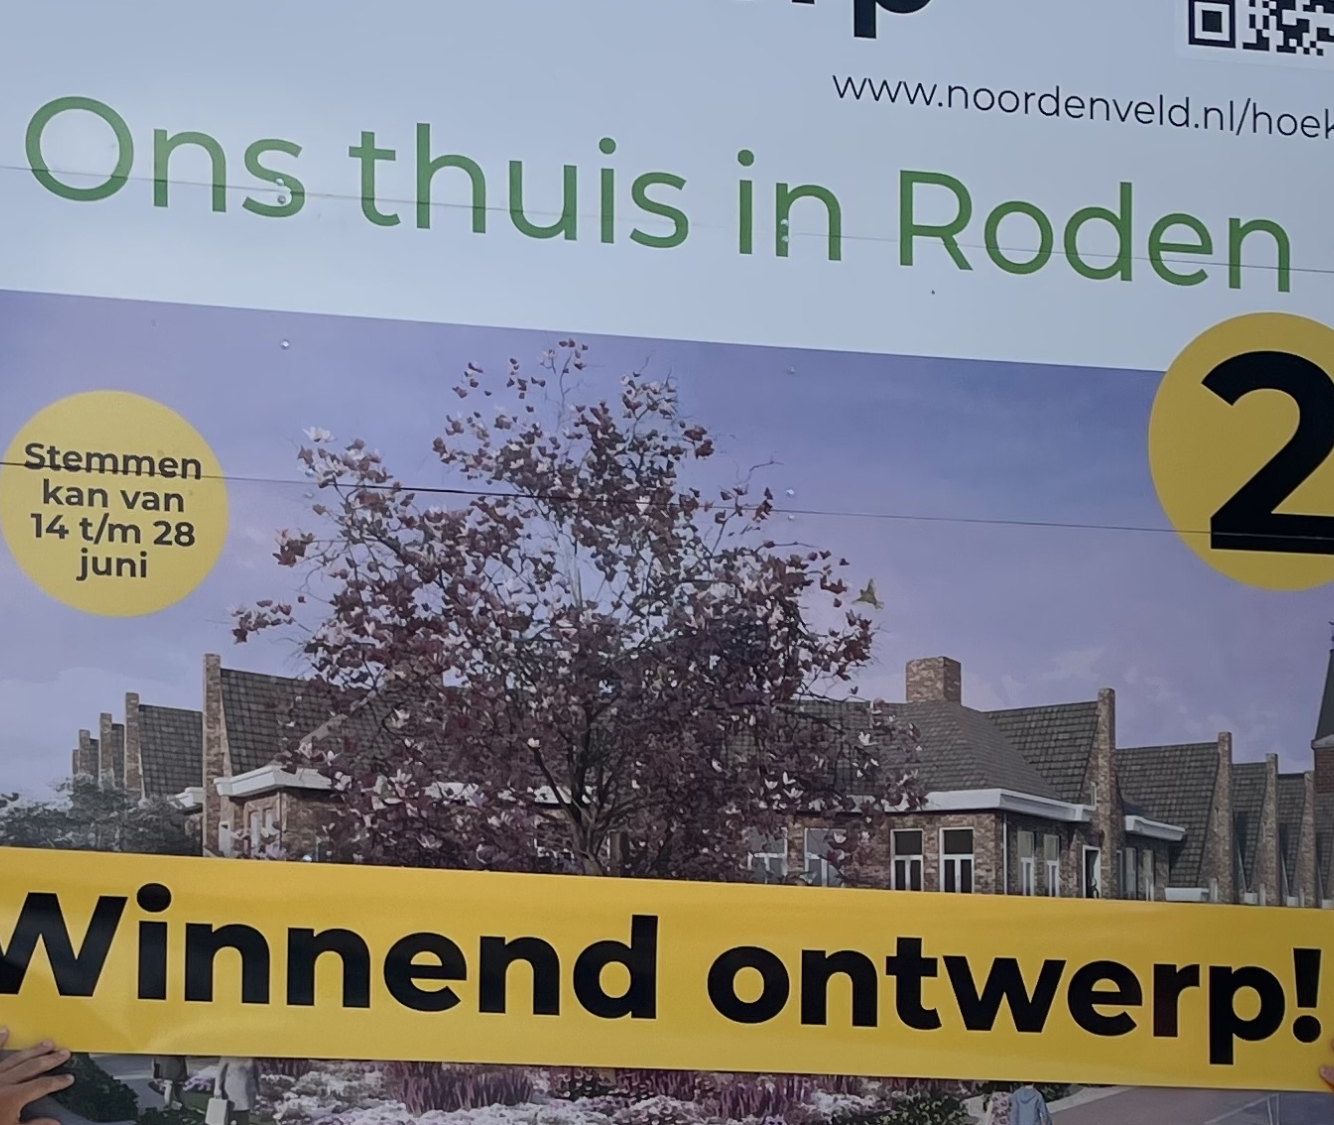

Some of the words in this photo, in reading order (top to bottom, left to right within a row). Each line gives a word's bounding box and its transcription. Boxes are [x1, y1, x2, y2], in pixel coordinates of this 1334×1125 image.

[25, 95, 306, 218] Ons
[349, 123, 689, 248] thuis
[737, 149, 841, 261] in
[899, 169, 1290, 293] Roden
[24, 443, 201, 479] Stemmen
[43, 478, 108, 507] kan
[120, 490, 184, 512] van
[31, 513, 69, 539] 14
[79, 513, 141, 544] t/m
[153, 520, 195, 547] 28
[76, 548, 147, 581] juni
[707, 936, 1322, 1065] ontwerp!
